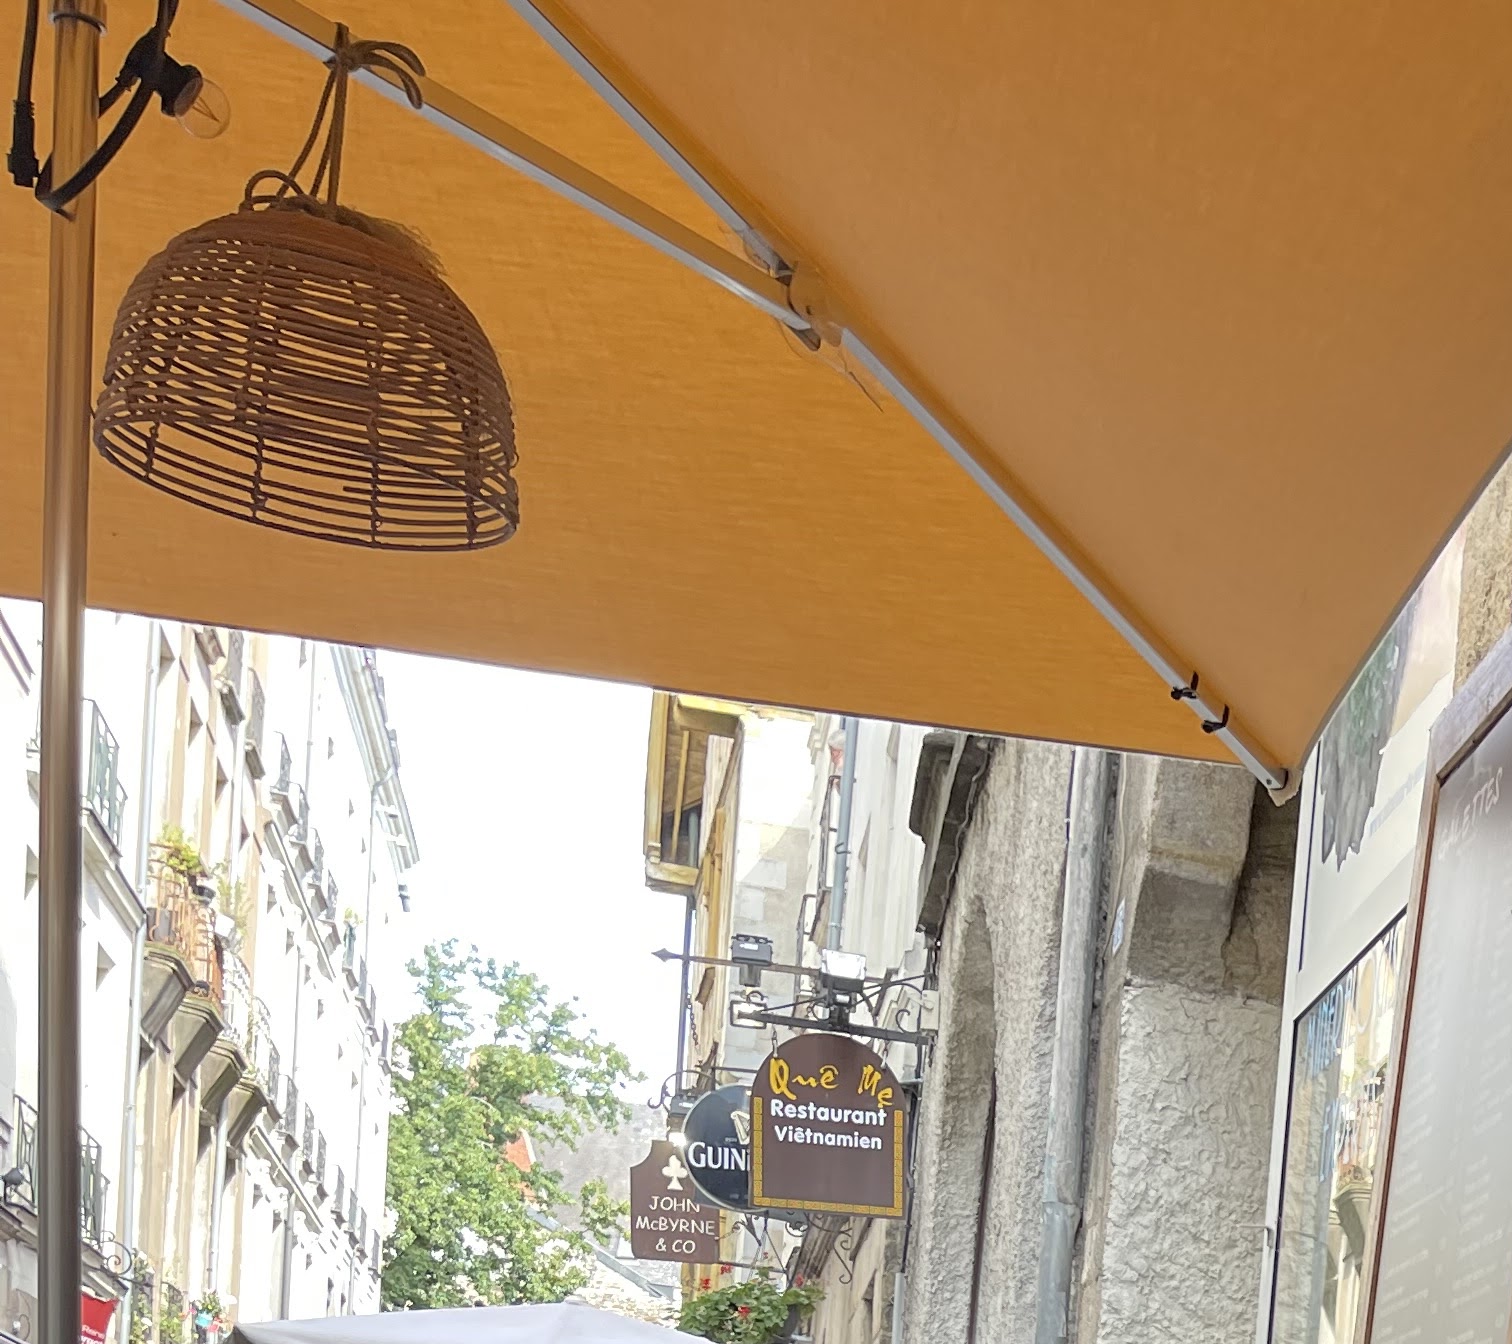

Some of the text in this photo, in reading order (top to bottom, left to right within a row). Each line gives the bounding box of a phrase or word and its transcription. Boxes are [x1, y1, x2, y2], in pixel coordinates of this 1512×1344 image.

[770, 1099, 887, 1126] Restaurant
[774, 1124, 883, 1150] Viêtnamien
[687, 1141, 750, 1172] GUIN
[649, 1195, 701, 1214] JOHN
[635, 1215, 716, 1236] McBYRNE
[655, 1238, 696, 1254] & CO
